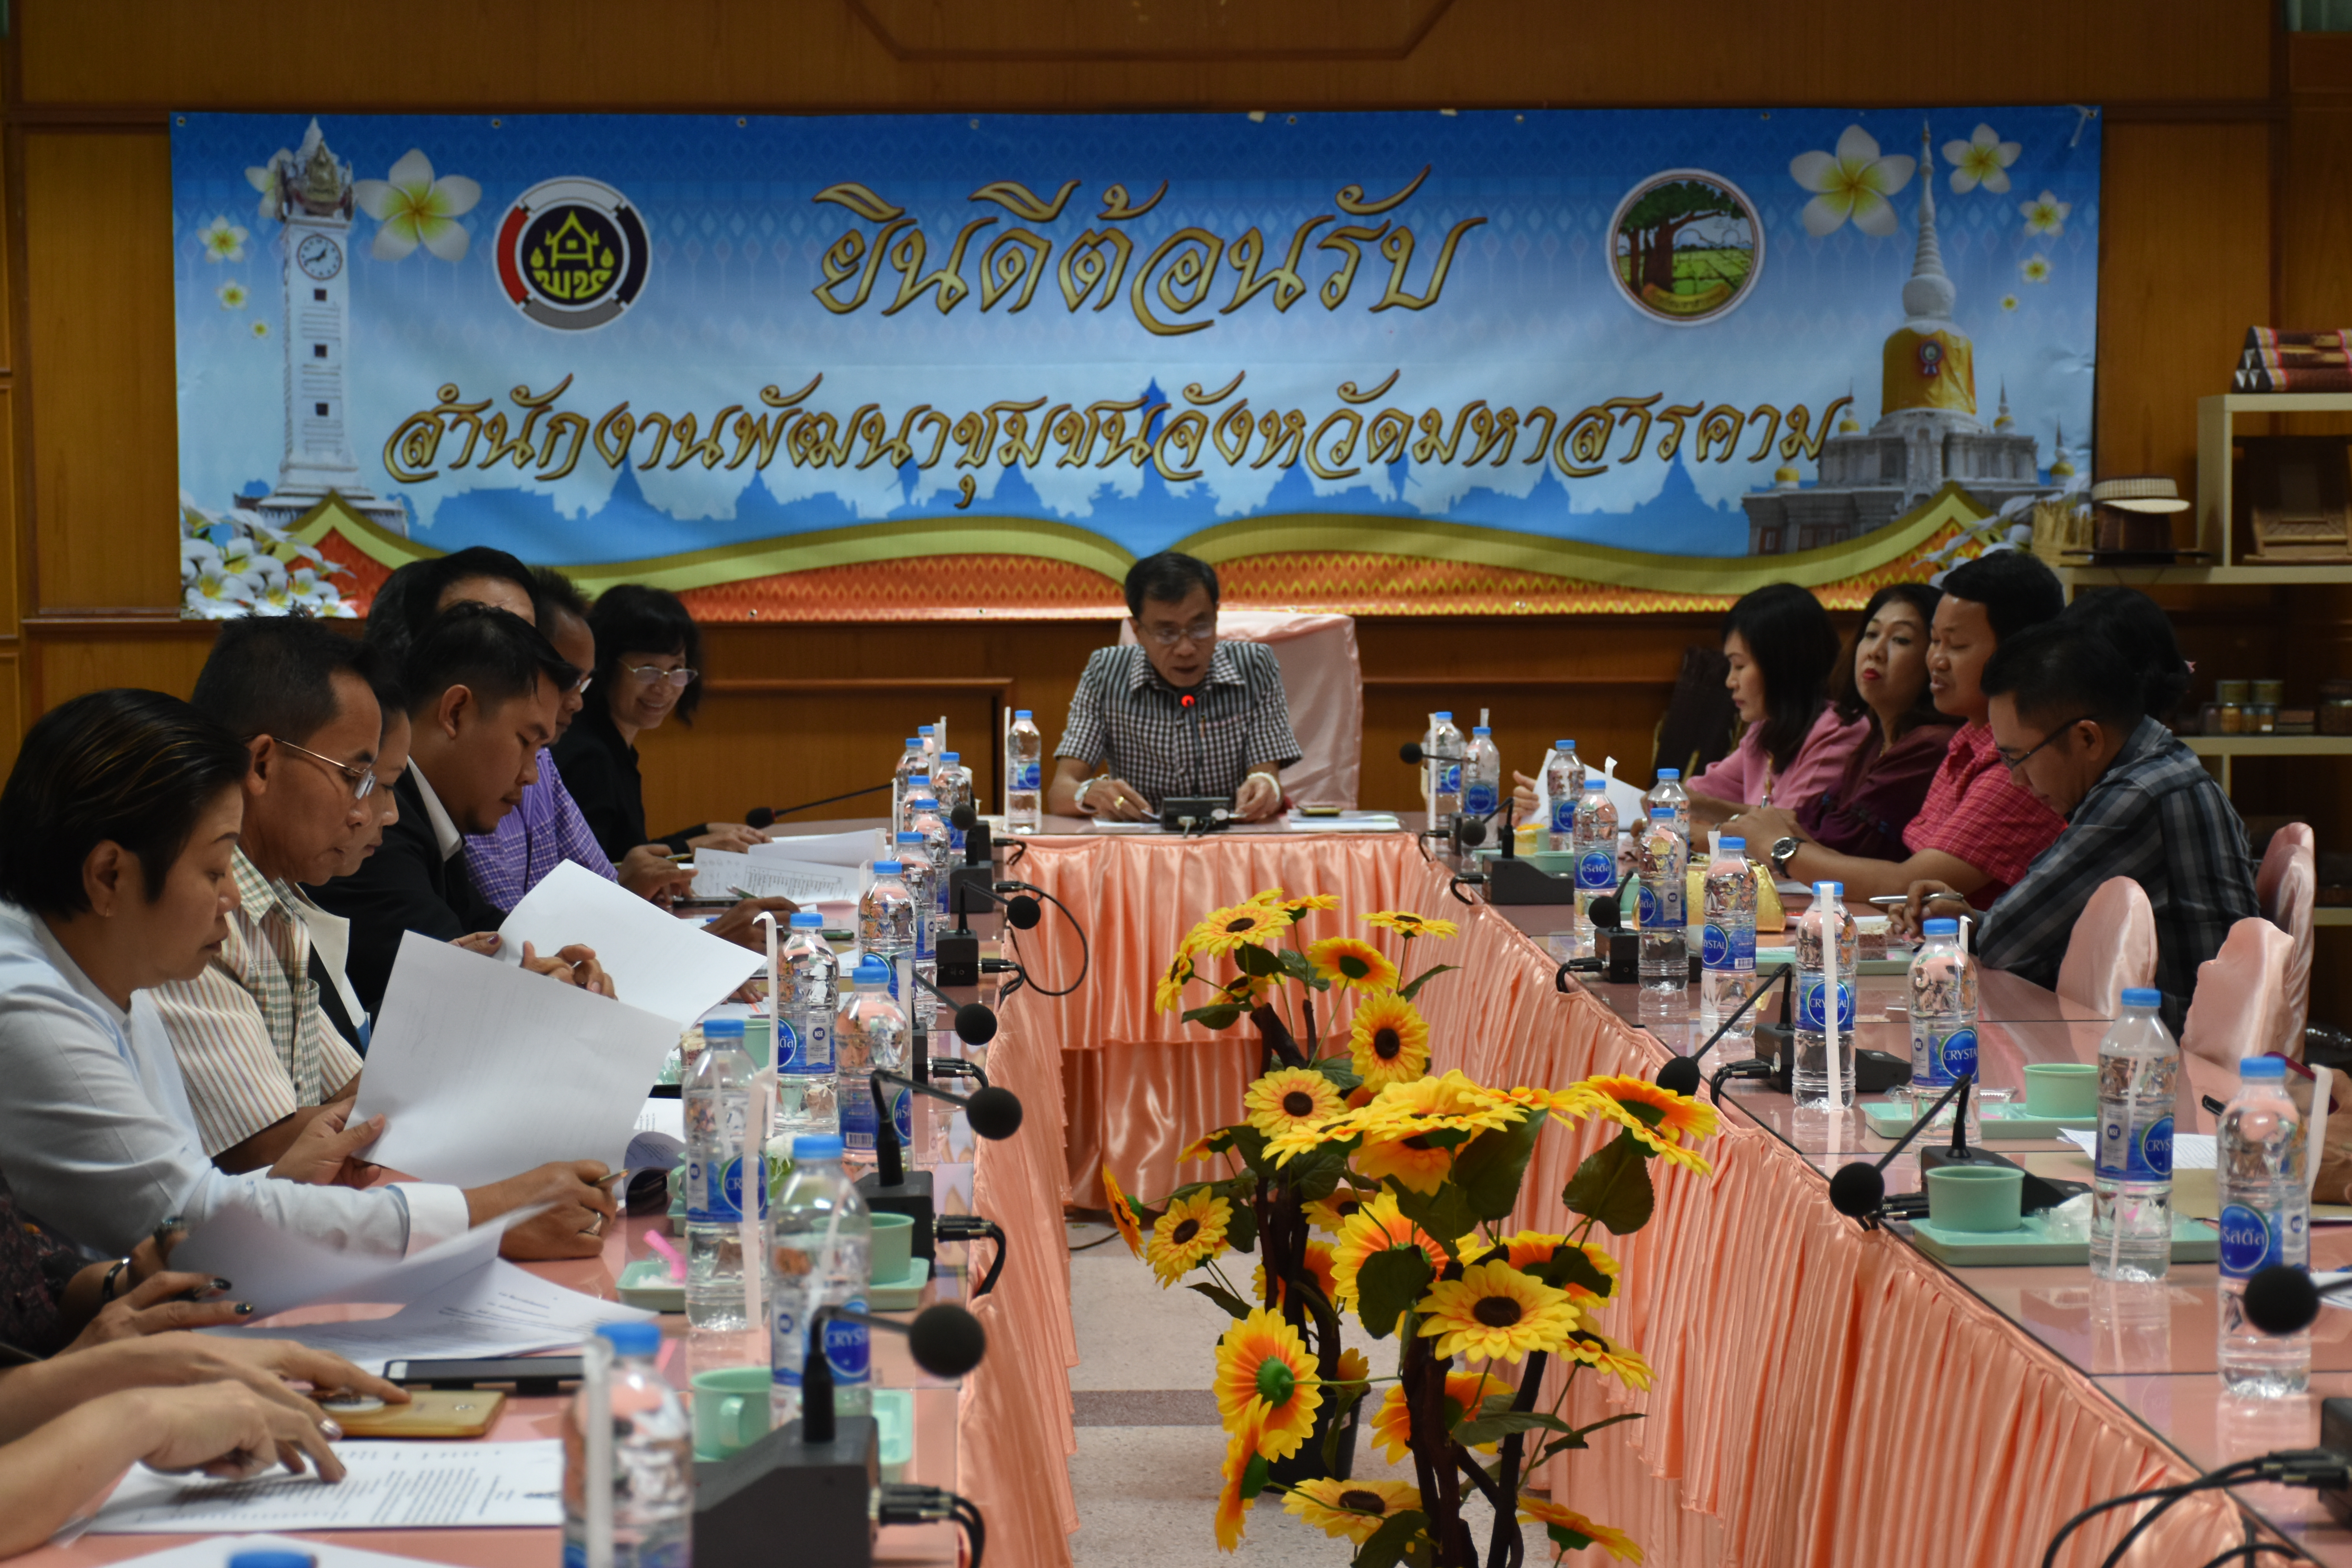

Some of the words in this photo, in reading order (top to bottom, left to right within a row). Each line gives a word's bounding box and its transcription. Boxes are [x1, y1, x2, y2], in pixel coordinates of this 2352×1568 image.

[812, 165, 1488, 336] ยินดีต้อนรับ
[1809, 998, 1847, 1008] CRYAL
[1944, 1048, 1978, 1061] CRYSTA
[2146, 1138, 2172, 1152] CRYS
[2221, 1227, 2265, 1245] ริสตัล
